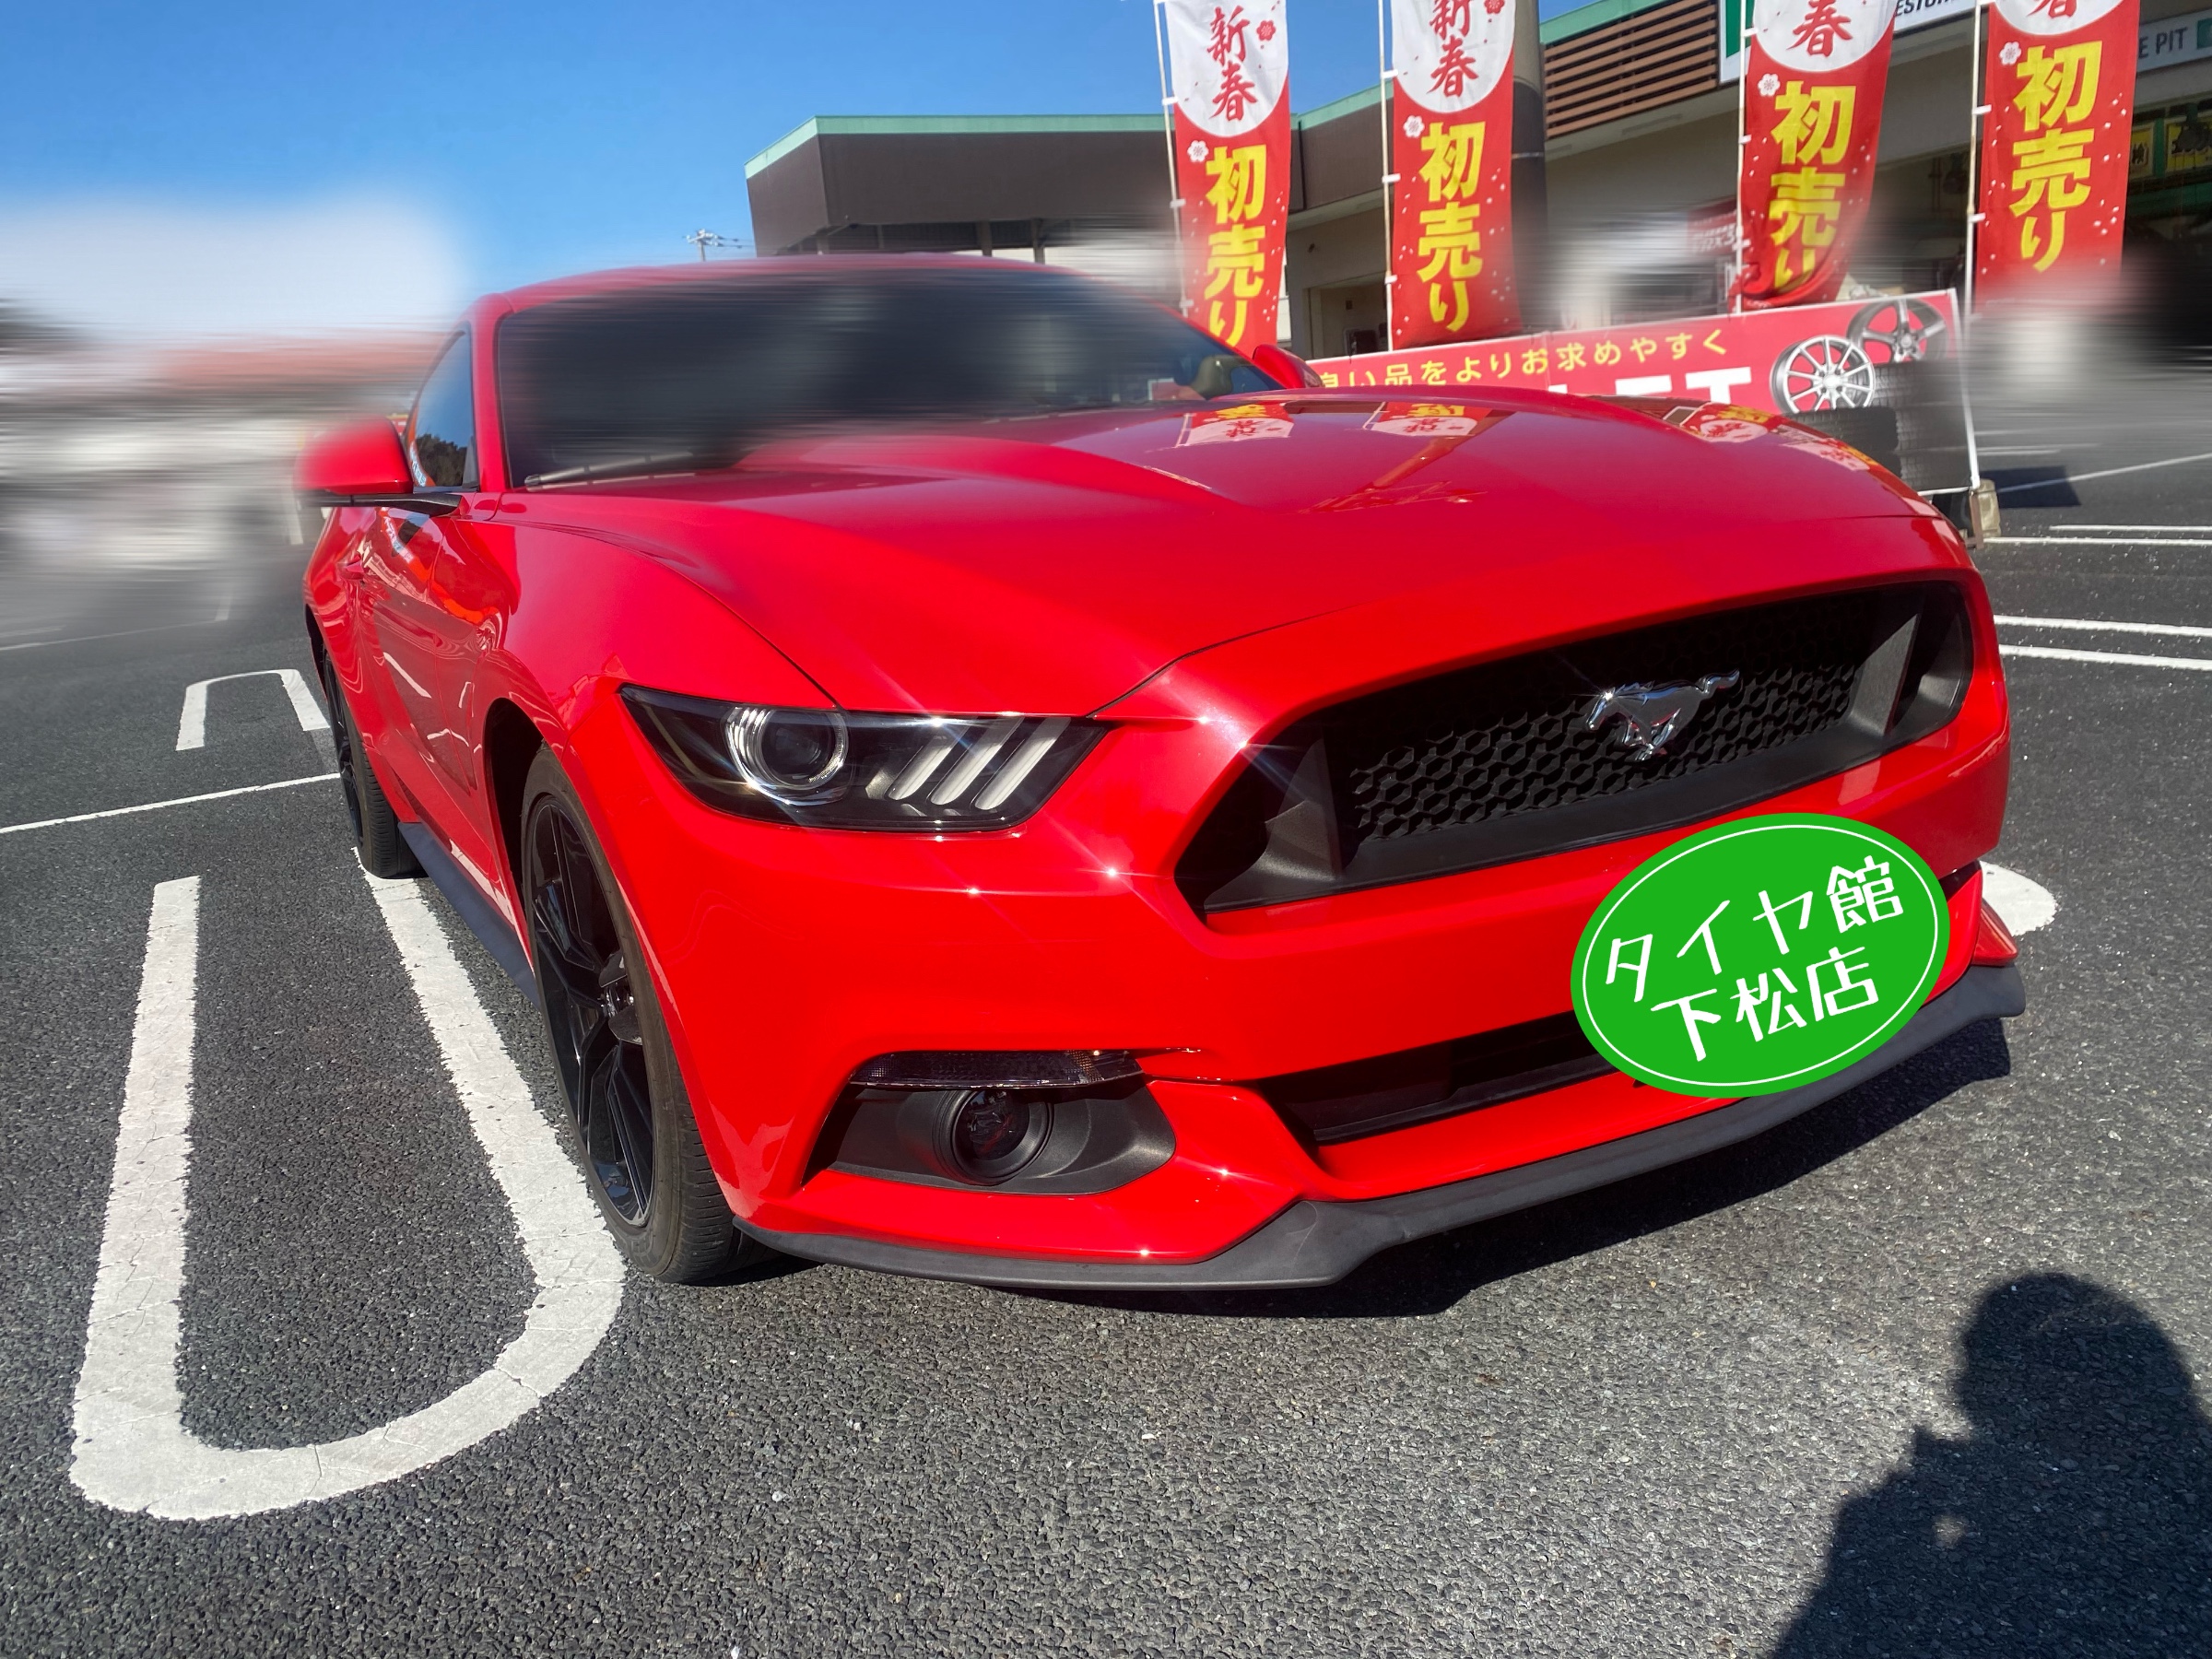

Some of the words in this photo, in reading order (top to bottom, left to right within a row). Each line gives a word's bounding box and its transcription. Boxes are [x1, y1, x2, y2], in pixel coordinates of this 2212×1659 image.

[1206, 5, 1256, 122] 新春
[2155, 27, 2188, 55] PIT
[1204, 144, 1267, 348] 初売り
[1417, 121, 1486, 333] 初売り
[1769, 81, 1856, 289] 初売り
[2009, 41, 2102, 273] 初売り
